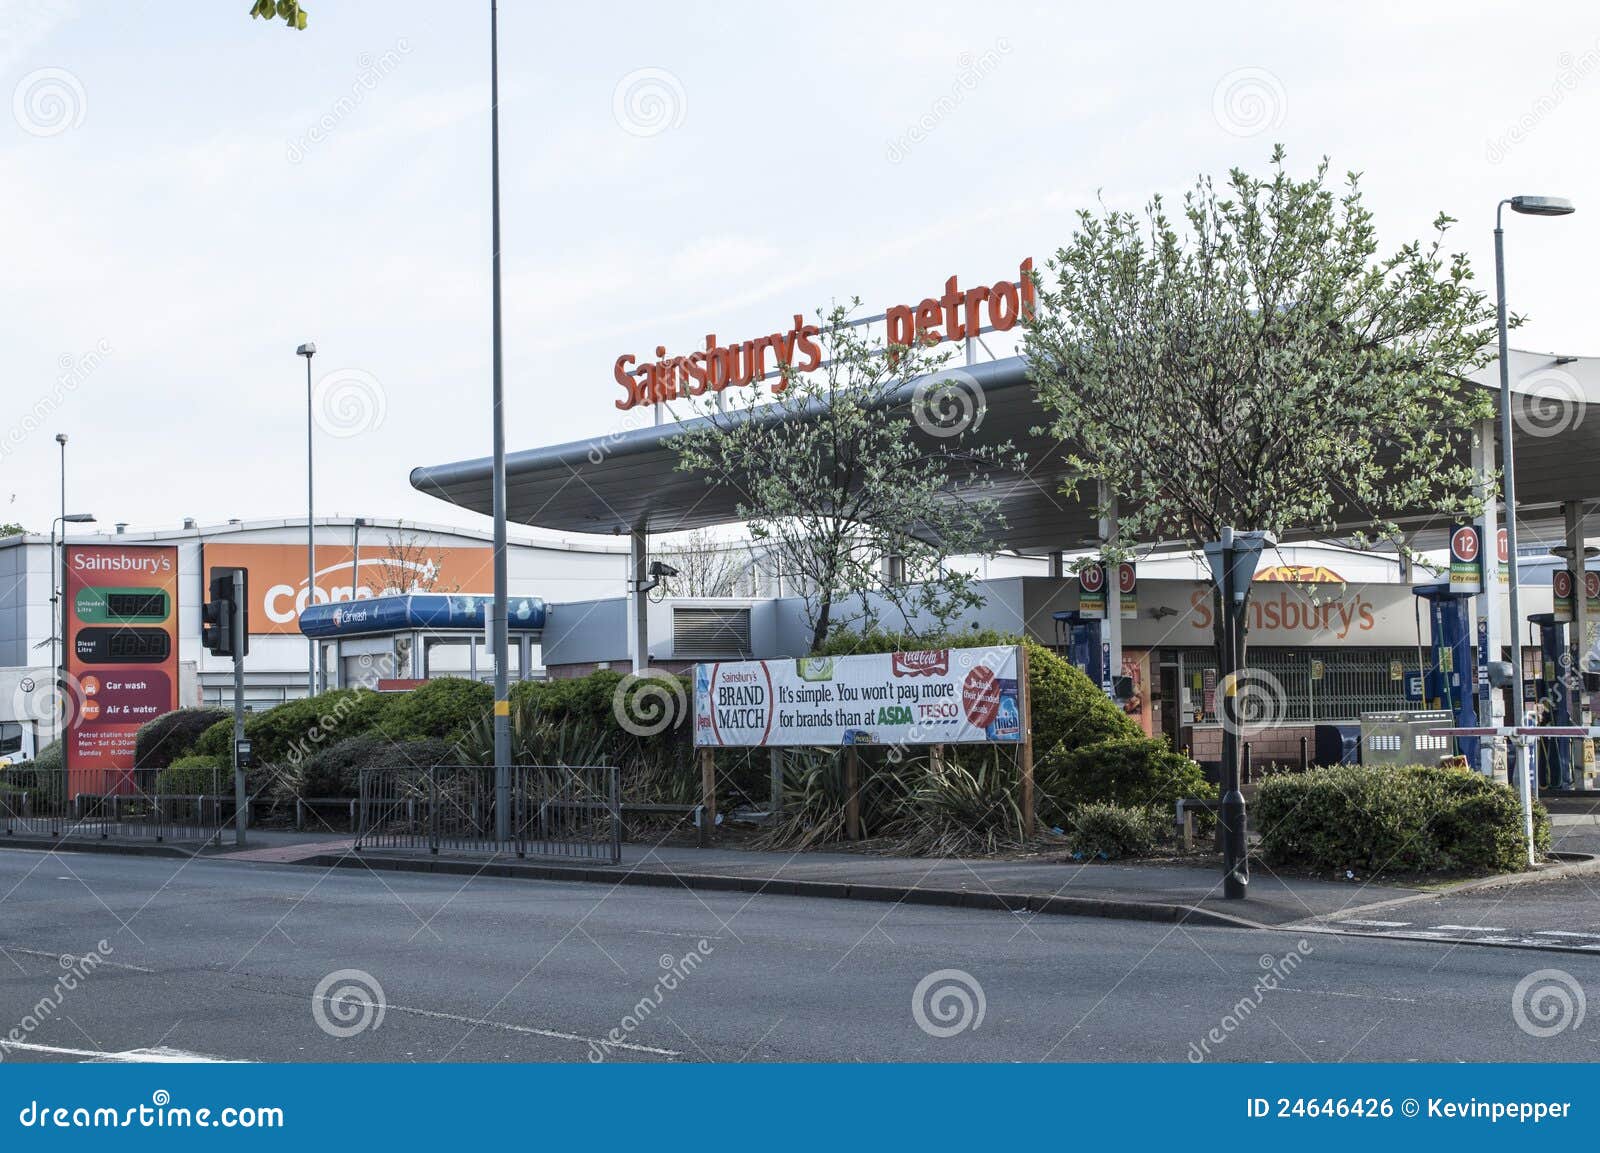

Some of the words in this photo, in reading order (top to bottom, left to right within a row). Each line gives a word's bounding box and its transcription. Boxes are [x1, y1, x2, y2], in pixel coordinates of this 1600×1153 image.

[614, 314, 821, 411] Sainsbury's
[886, 256, 1034, 369] petrol
[1459, 536, 1474, 552] 12
[74, 553, 170, 574] Sainsbury's
[1084, 570, 1098, 583] 10
[1121, 571, 1129, 584] 9
[1559, 578, 1566, 591] 6
[1190, 590, 1374, 639] Snsbury's
[106, 681, 121, 690] Car
[124, 681, 147, 690] wash
[722, 671, 757, 684] Sainsbury's
[718, 686, 764, 706] BRAND
[779, 685, 794, 704] It's
[796, 683, 834, 707] simple.
[837, 682, 858, 701] You
[861, 681, 894, 700] won't
[896, 684, 919, 704] pay
[922, 683, 954, 698] more
[106, 705, 120, 714] Air
[122, 705, 130, 714] &
[132, 705, 157, 714] water
[718, 708, 765, 729] MATCH
[780, 709, 794, 728] for
[796, 708, 833, 727] brands
[835, 708, 861, 727] than
[864, 708, 875, 726] at
[877, 705, 914, 725] ASDA
[918, 703, 959, 718] TESCO
